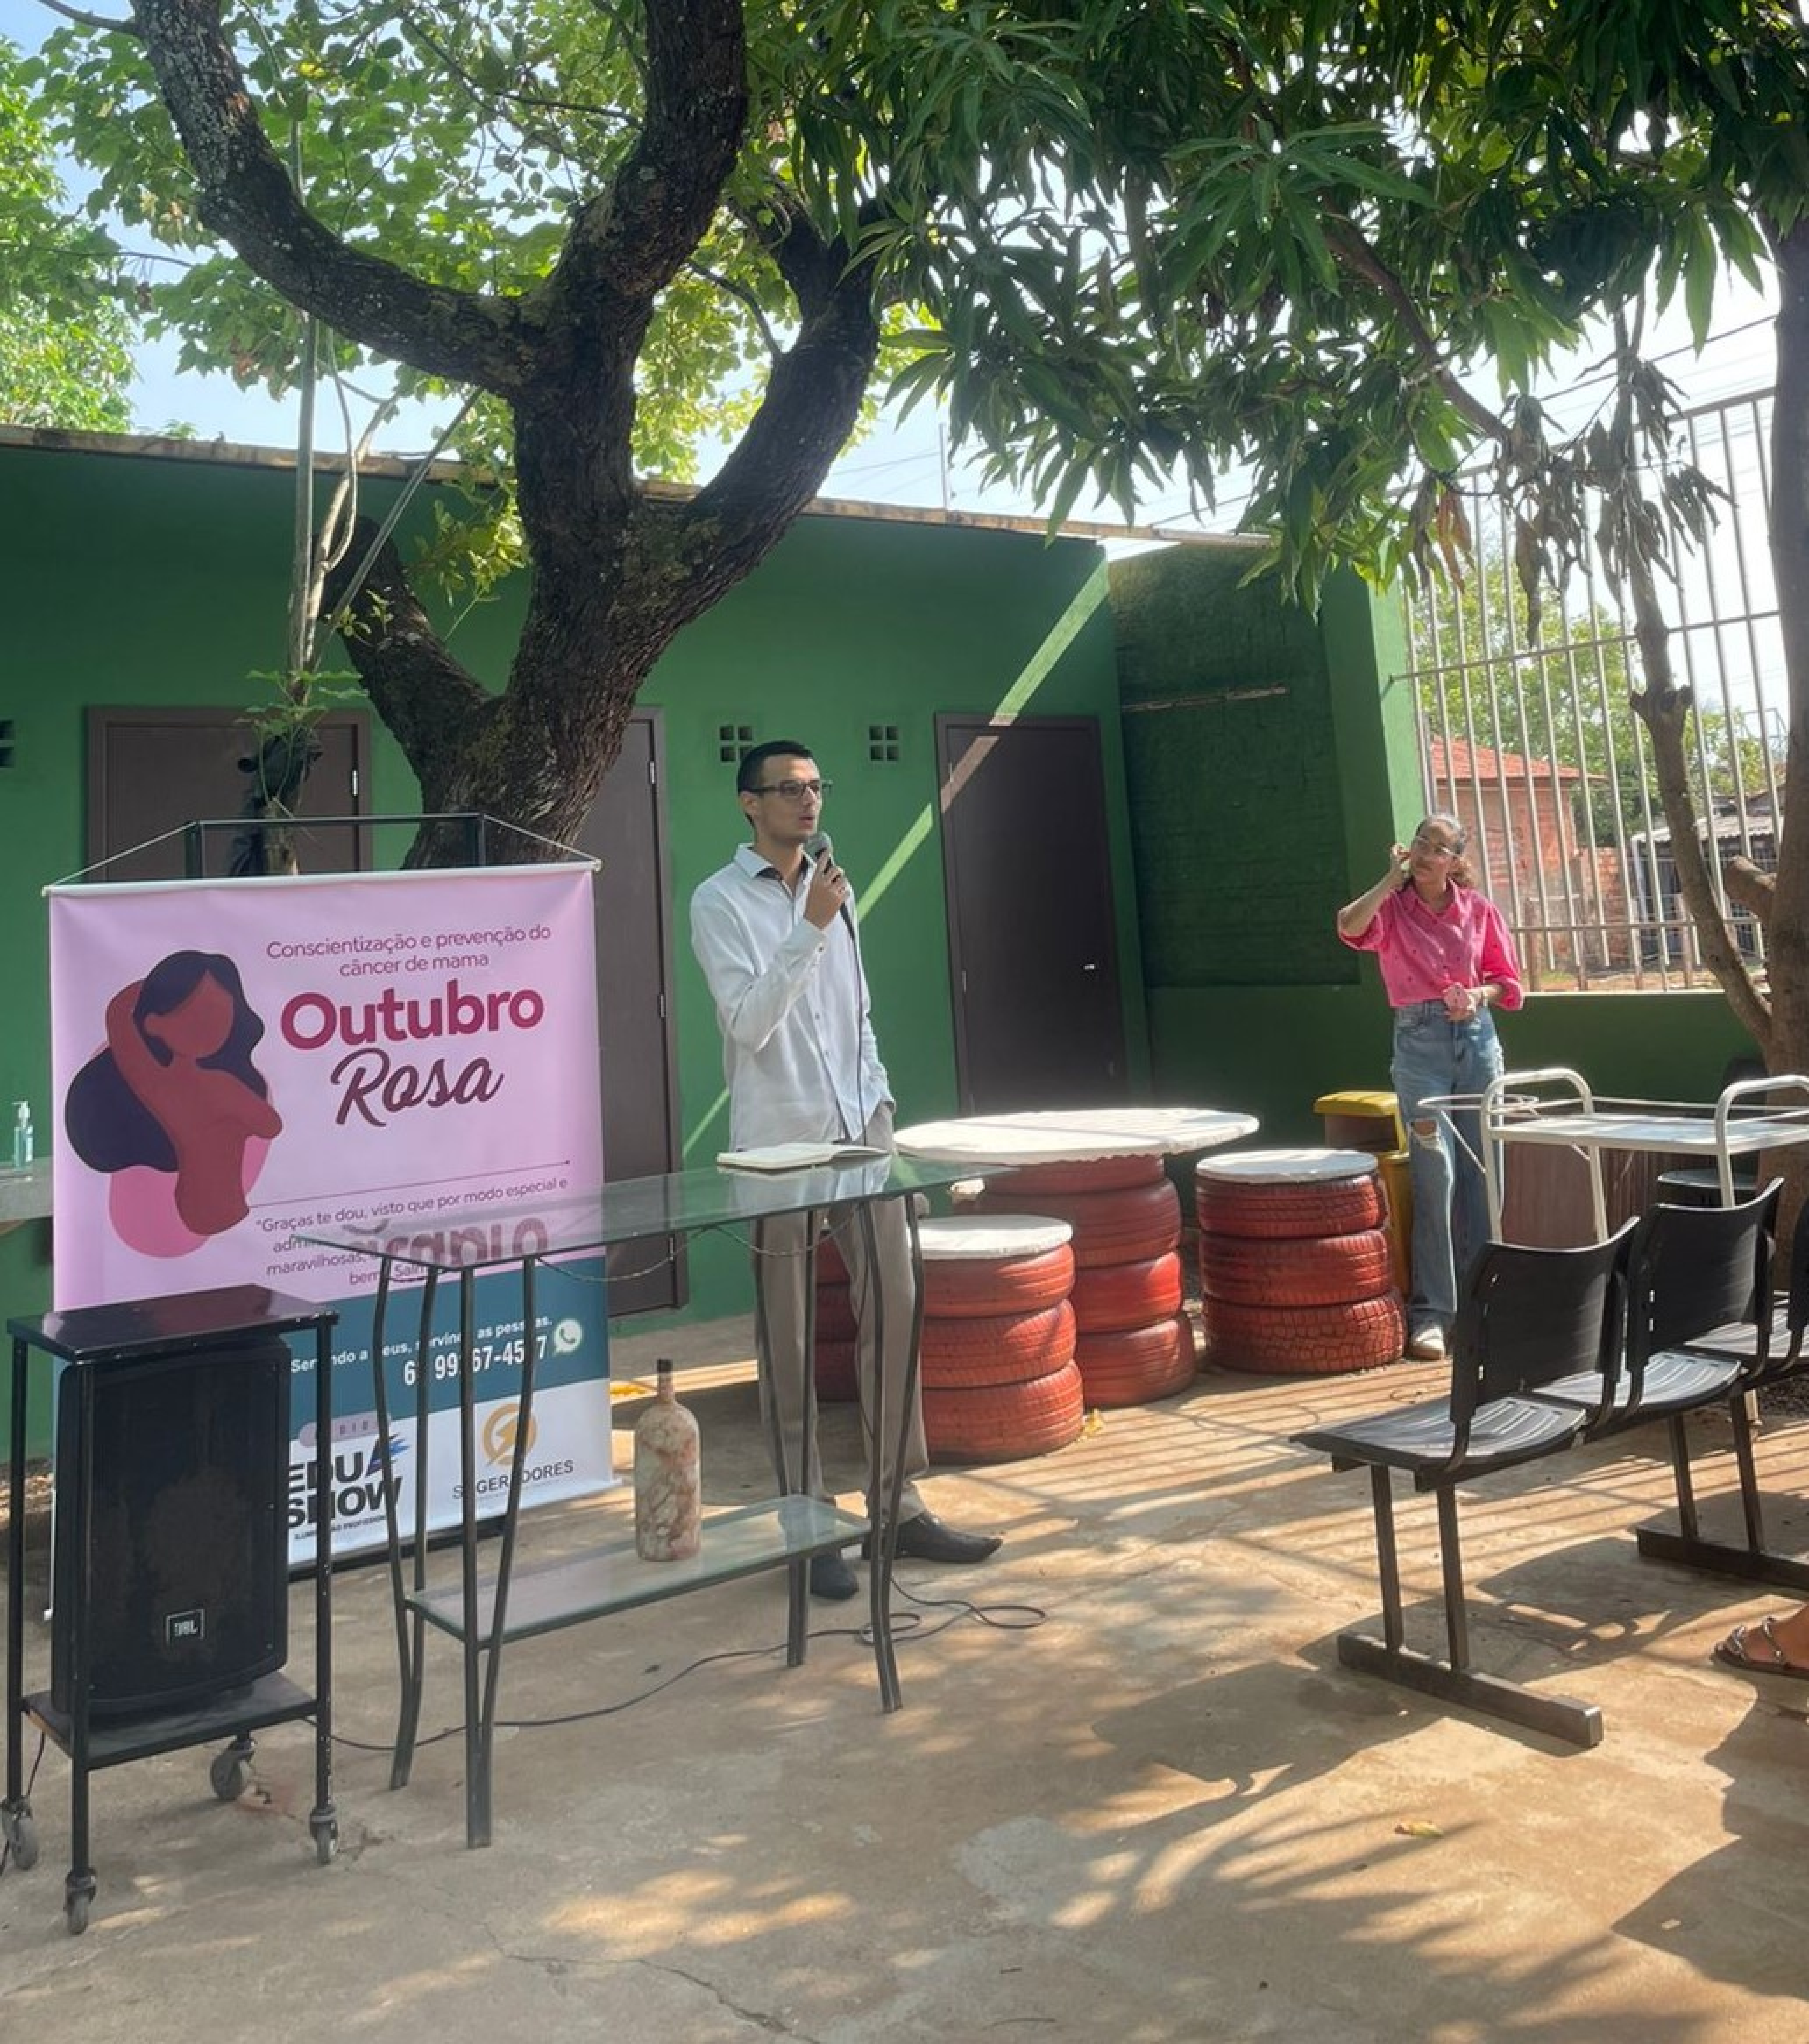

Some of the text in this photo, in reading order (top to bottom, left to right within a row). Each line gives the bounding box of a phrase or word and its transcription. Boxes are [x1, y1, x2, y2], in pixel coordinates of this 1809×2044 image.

[266, 924, 551, 958] Conscientização e prevenção do
[340, 954, 489, 977] câncer de mama
[280, 978, 544, 1050] Outubro
[331, 1048, 504, 1127] Rosa
[317, 1213, 332, 1224] te
[372, 1202, 404, 1216] visto
[408, 1199, 433, 1213] que
[438, 1195, 461, 1209] por
[464, 1188, 504, 1203] modo
[507, 1178, 556, 1198] especial
[559, 1178, 569, 1189] e
[290, 1349, 356, 1373] Serndo
[359, 1349, 369, 1361] a
[376, 1342, 412, 1358] eus,
[496, 1316, 553, 1338] pessas.
[452, 1459, 574, 1500] SGERDORES
